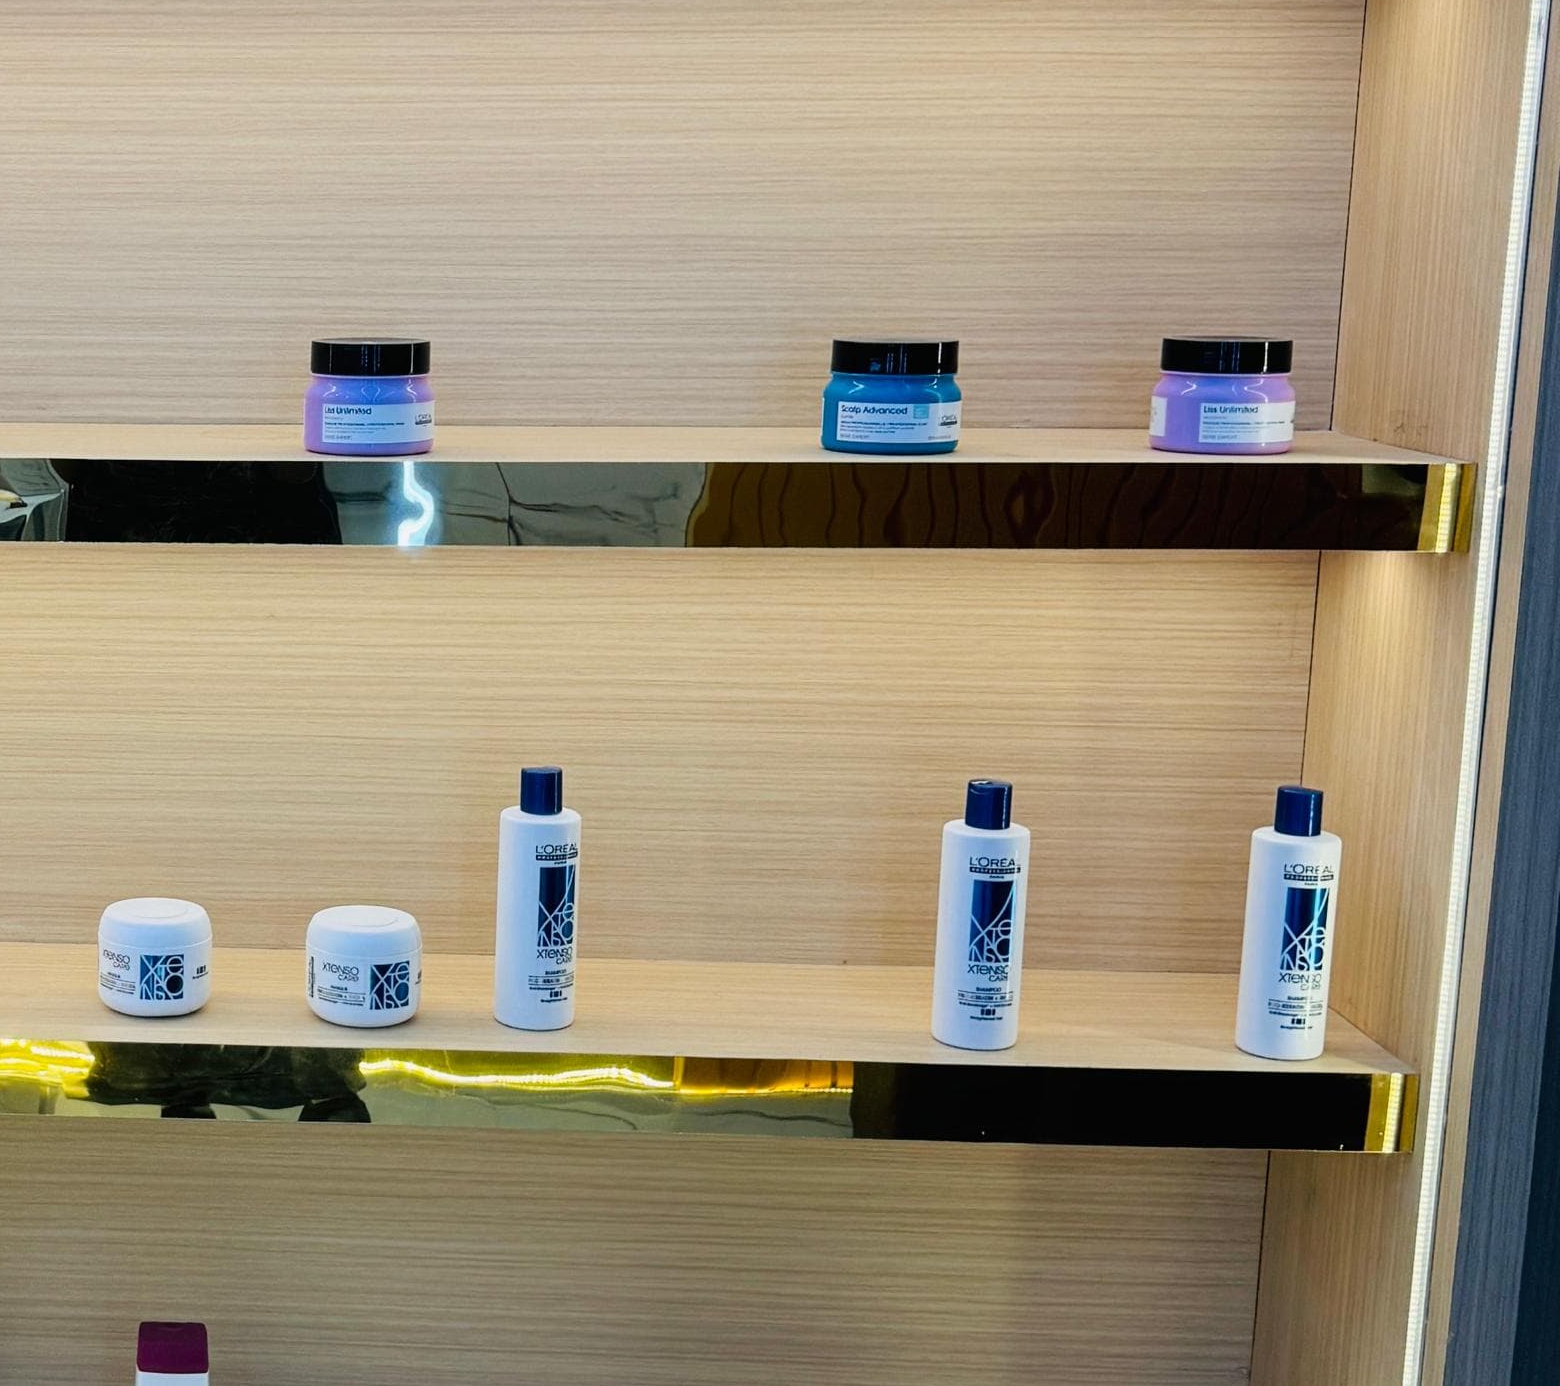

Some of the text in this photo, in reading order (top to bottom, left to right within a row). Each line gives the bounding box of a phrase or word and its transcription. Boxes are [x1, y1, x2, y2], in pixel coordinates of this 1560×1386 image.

[840, 404, 908, 415] Scalp Advanced
[1203, 405, 1259, 414] Liss Unlimited
